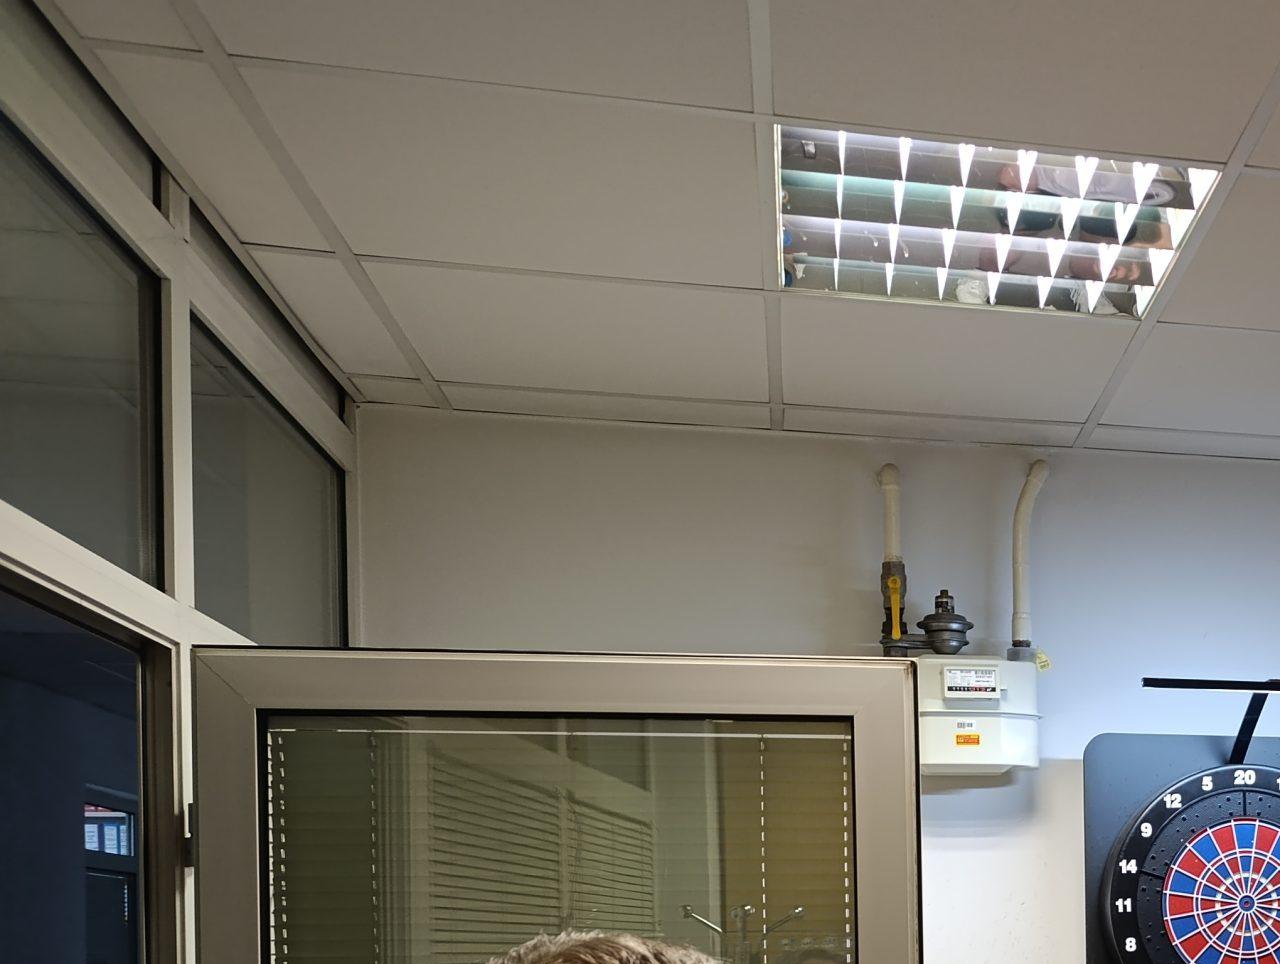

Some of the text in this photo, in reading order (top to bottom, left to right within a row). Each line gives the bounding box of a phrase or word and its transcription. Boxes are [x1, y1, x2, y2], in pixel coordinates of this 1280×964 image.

[1201, 776, 1213, 790] 5
[1234, 770, 1256, 784] 20
[1163, 794, 1182, 808] 12
[1140, 823, 1152, 837] 9
[1119, 859, 1137, 873] 14
[1116, 898, 1132, 912] 11
[1125, 938, 1137, 951] 8
